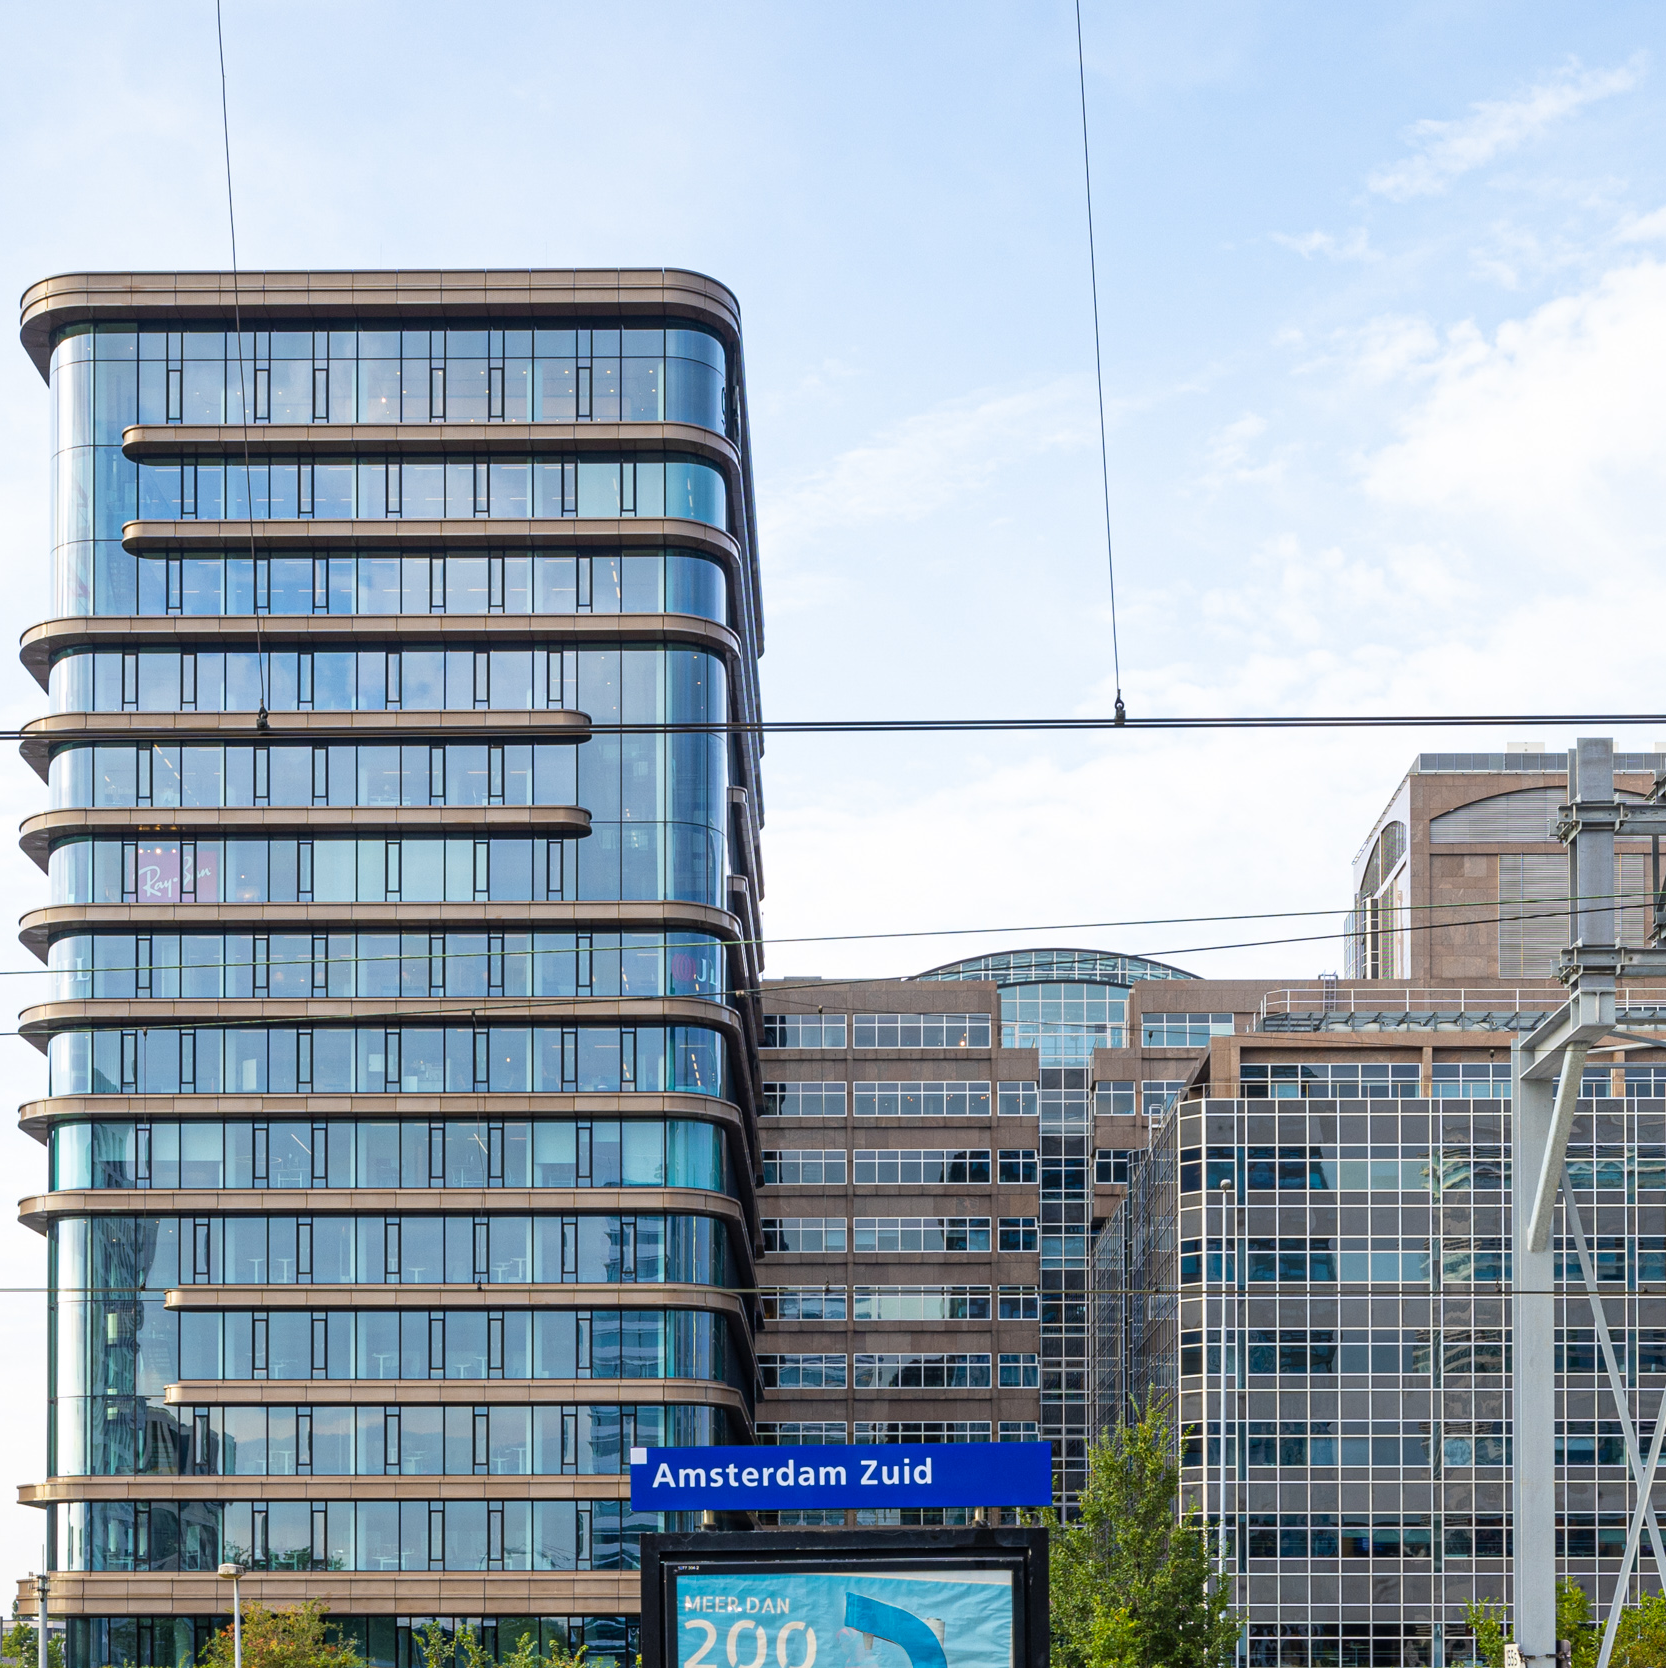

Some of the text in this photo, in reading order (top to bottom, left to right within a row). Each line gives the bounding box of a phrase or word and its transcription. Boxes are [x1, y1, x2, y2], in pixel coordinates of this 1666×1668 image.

[652, 1457, 933, 1488] Amsterdam Zuid
[684, 1595, 790, 1614] MEER DAN
